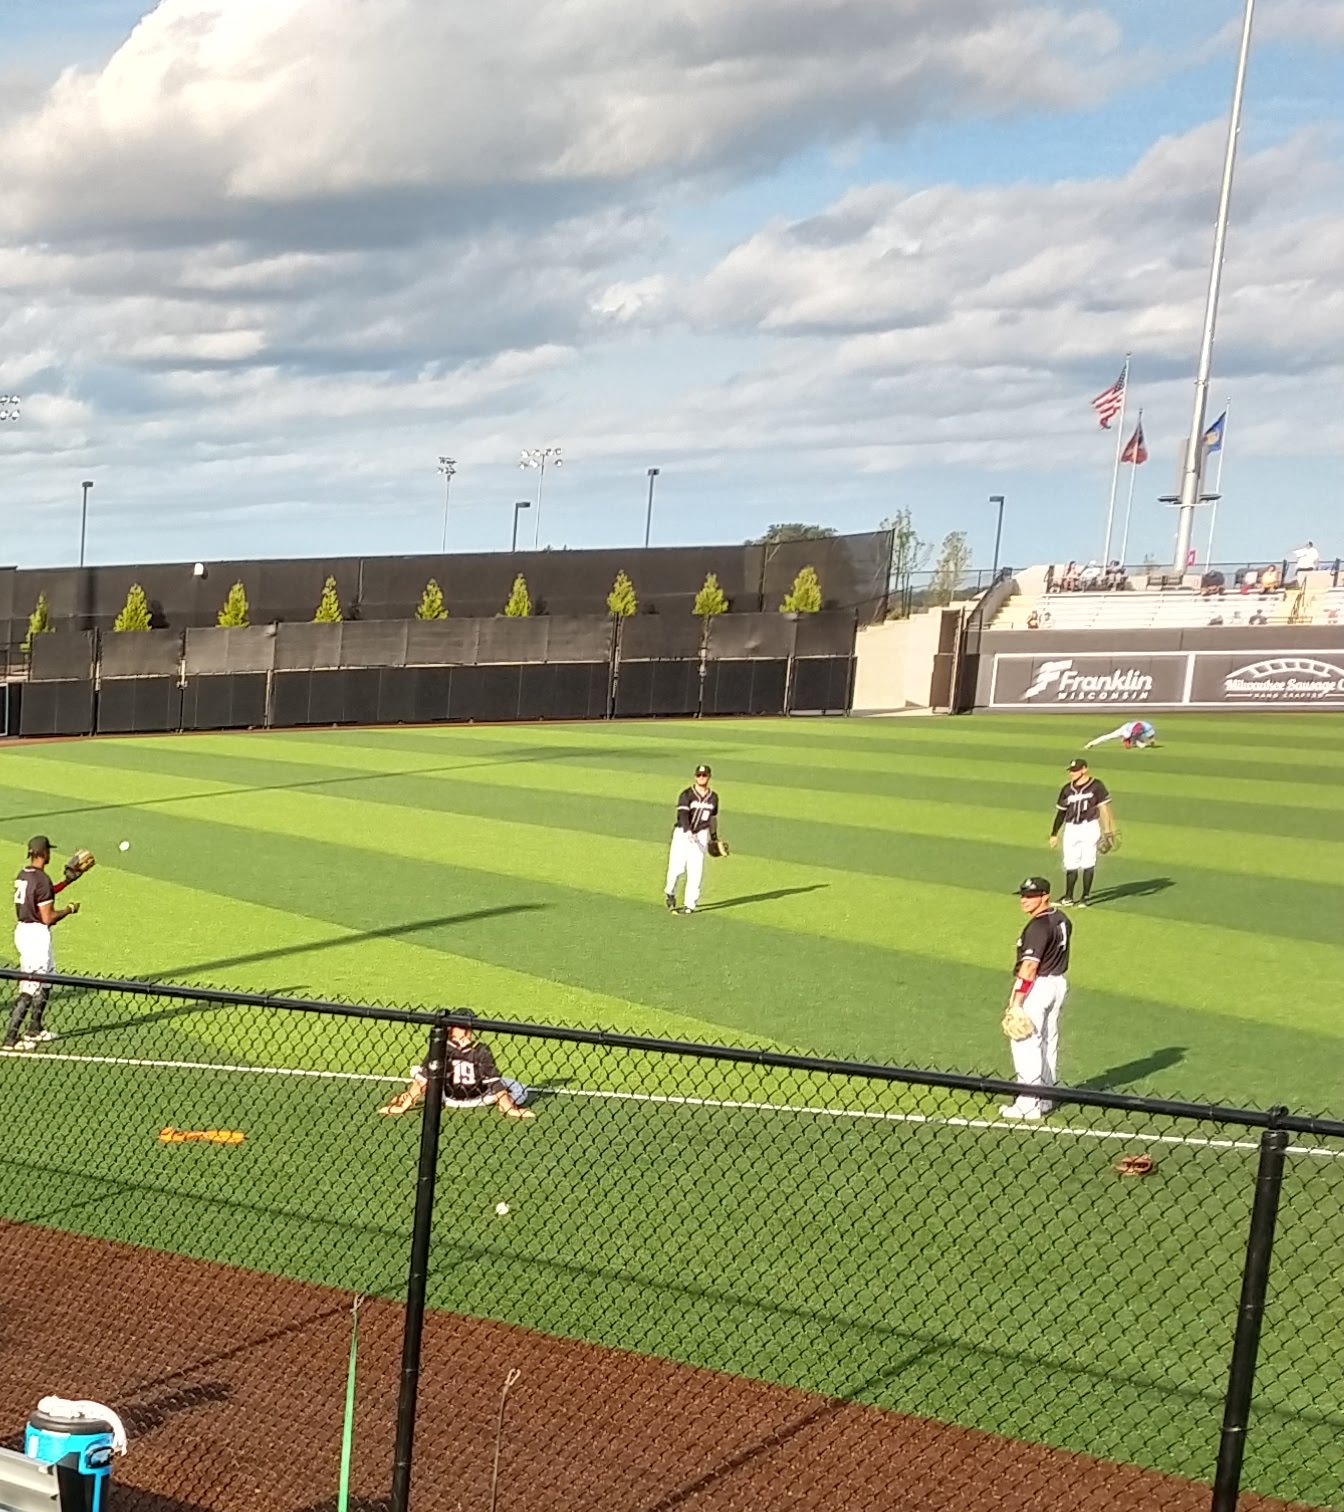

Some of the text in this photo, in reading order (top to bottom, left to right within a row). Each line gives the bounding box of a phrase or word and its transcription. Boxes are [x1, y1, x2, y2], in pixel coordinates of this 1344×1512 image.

[1058, 668, 1153, 692] Franklin
[1224, 679, 1286, 691] Milwaukee
[1286, 679, 1337, 695] Sausage
[1057, 692, 1149, 700] WISCONSIN
[452, 1060, 476, 1085] 19
